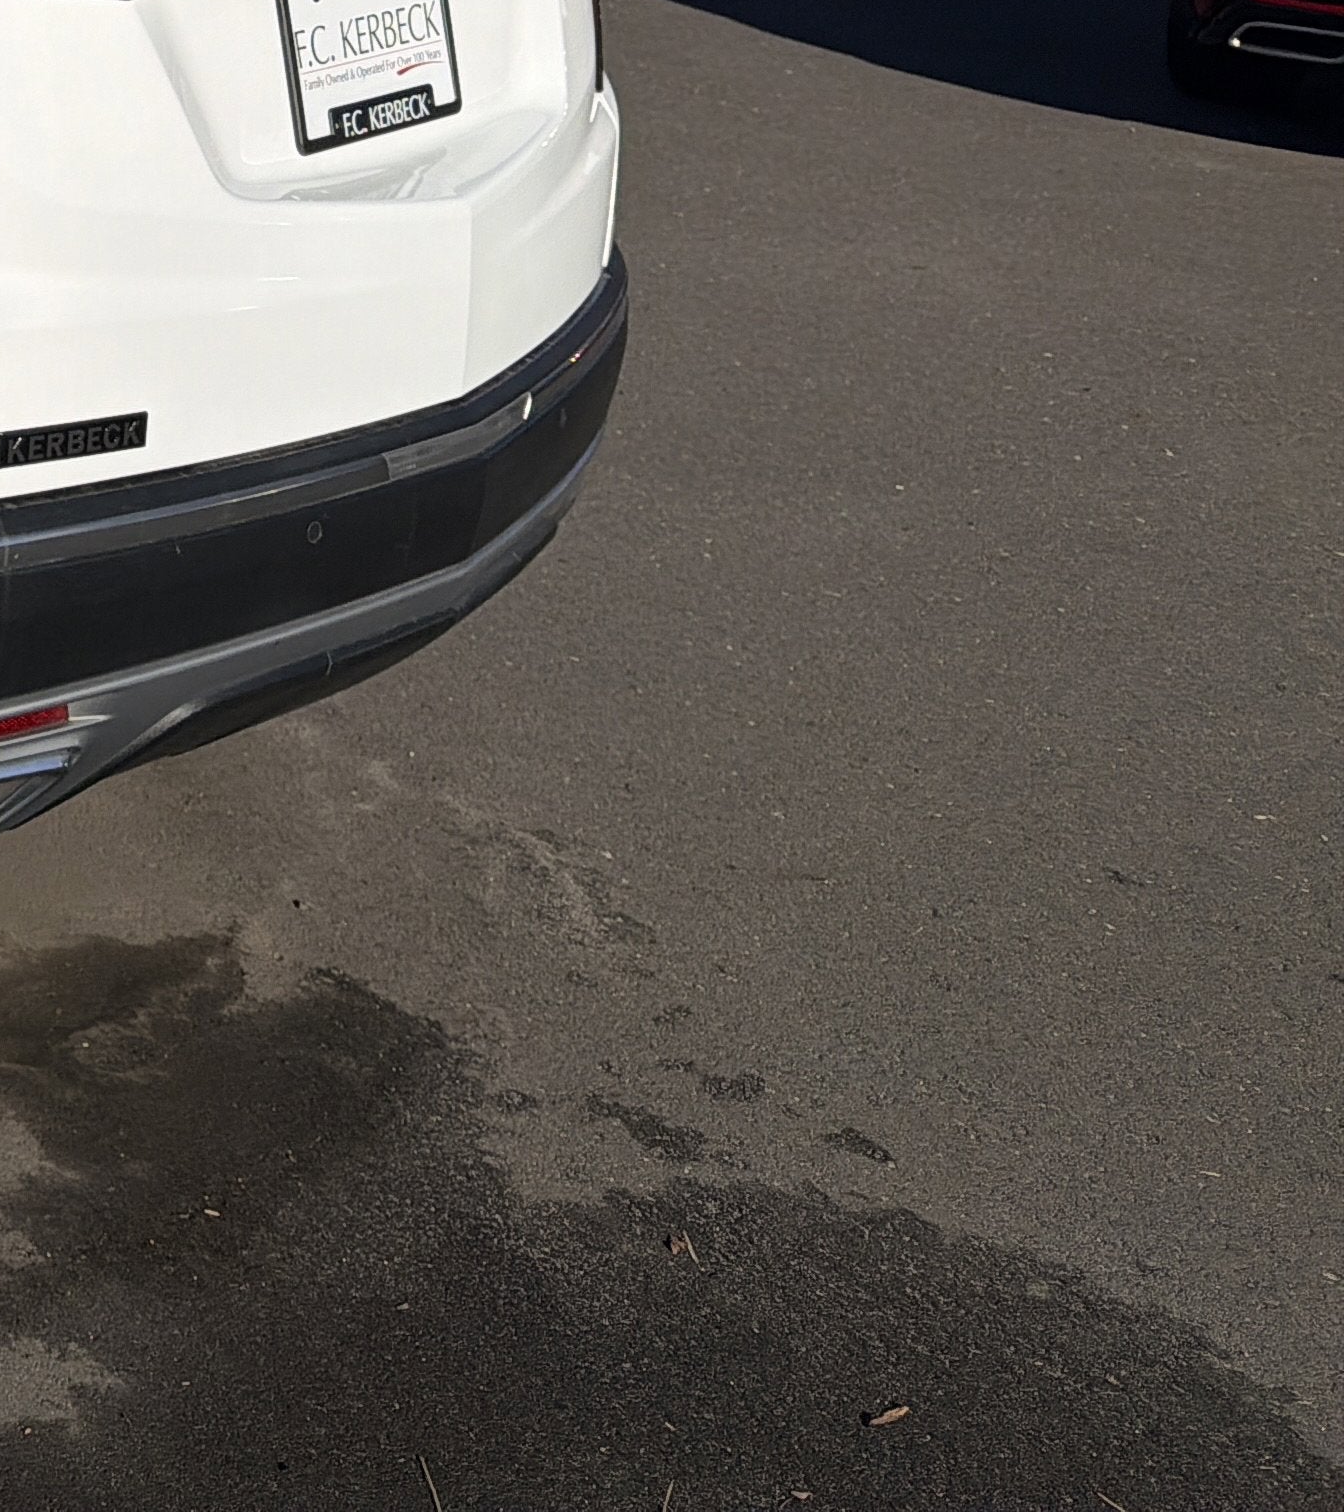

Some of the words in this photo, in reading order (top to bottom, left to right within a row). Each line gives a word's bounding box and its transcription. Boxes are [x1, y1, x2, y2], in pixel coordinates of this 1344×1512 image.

[294, 25, 336, 69] F.C.
[339, 0, 440, 59] KERBECK
[303, 77, 325, 91] Family
[325, 69, 349, 87] Owned
[356, 60, 385, 79] Operated
[386, 59, 396, 71] For
[396, 56, 412, 67] Over
[413, 51, 425, 62] 100
[425, 49, 442, 60] Years
[342, 109, 368, 138] F.C.
[368, 92, 430, 131] KERBECK
[7, 419, 141, 464] KERBECK
